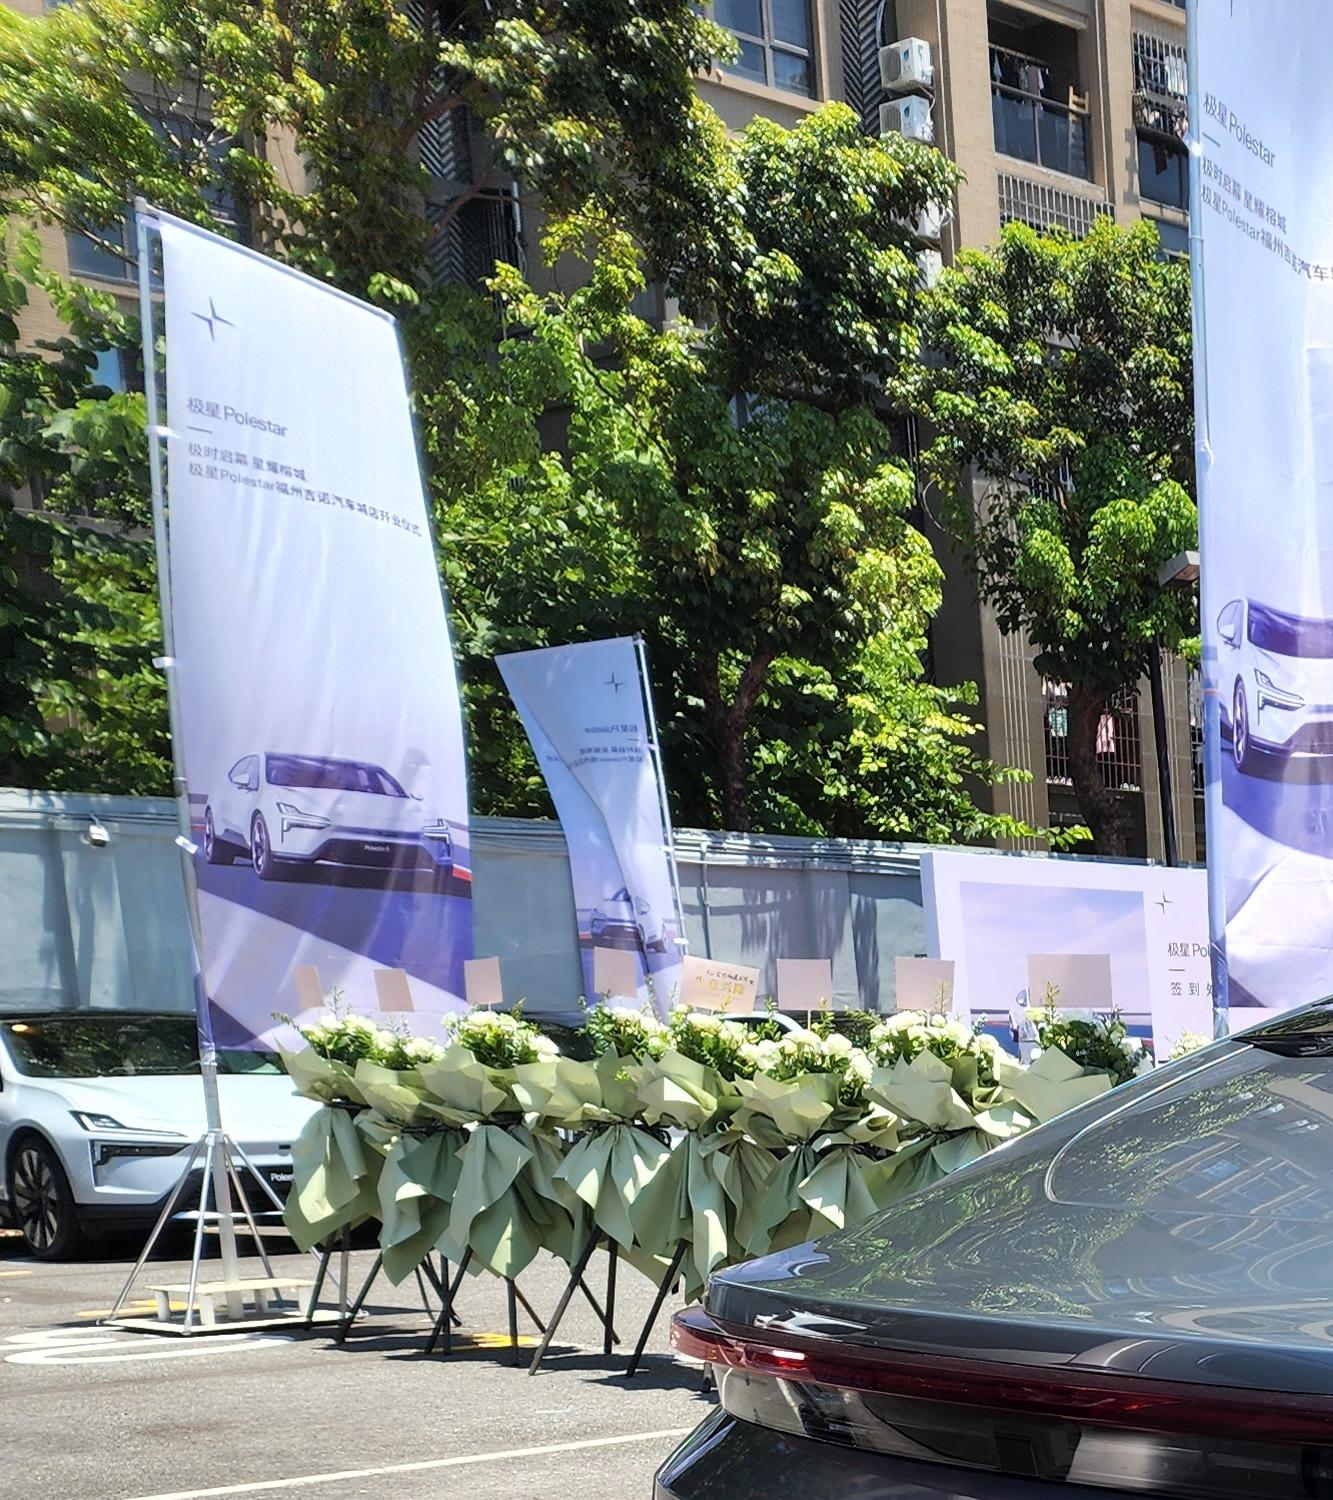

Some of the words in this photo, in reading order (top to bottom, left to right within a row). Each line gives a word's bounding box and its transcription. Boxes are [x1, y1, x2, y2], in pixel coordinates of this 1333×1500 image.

[1203, 91, 1228, 129] 极星
[1229, 112, 1276, 168] Polestar
[187, 397, 222, 420] 极星
[224, 406, 288, 437] Polestar
[1168, 941, 1190, 957] 极星
